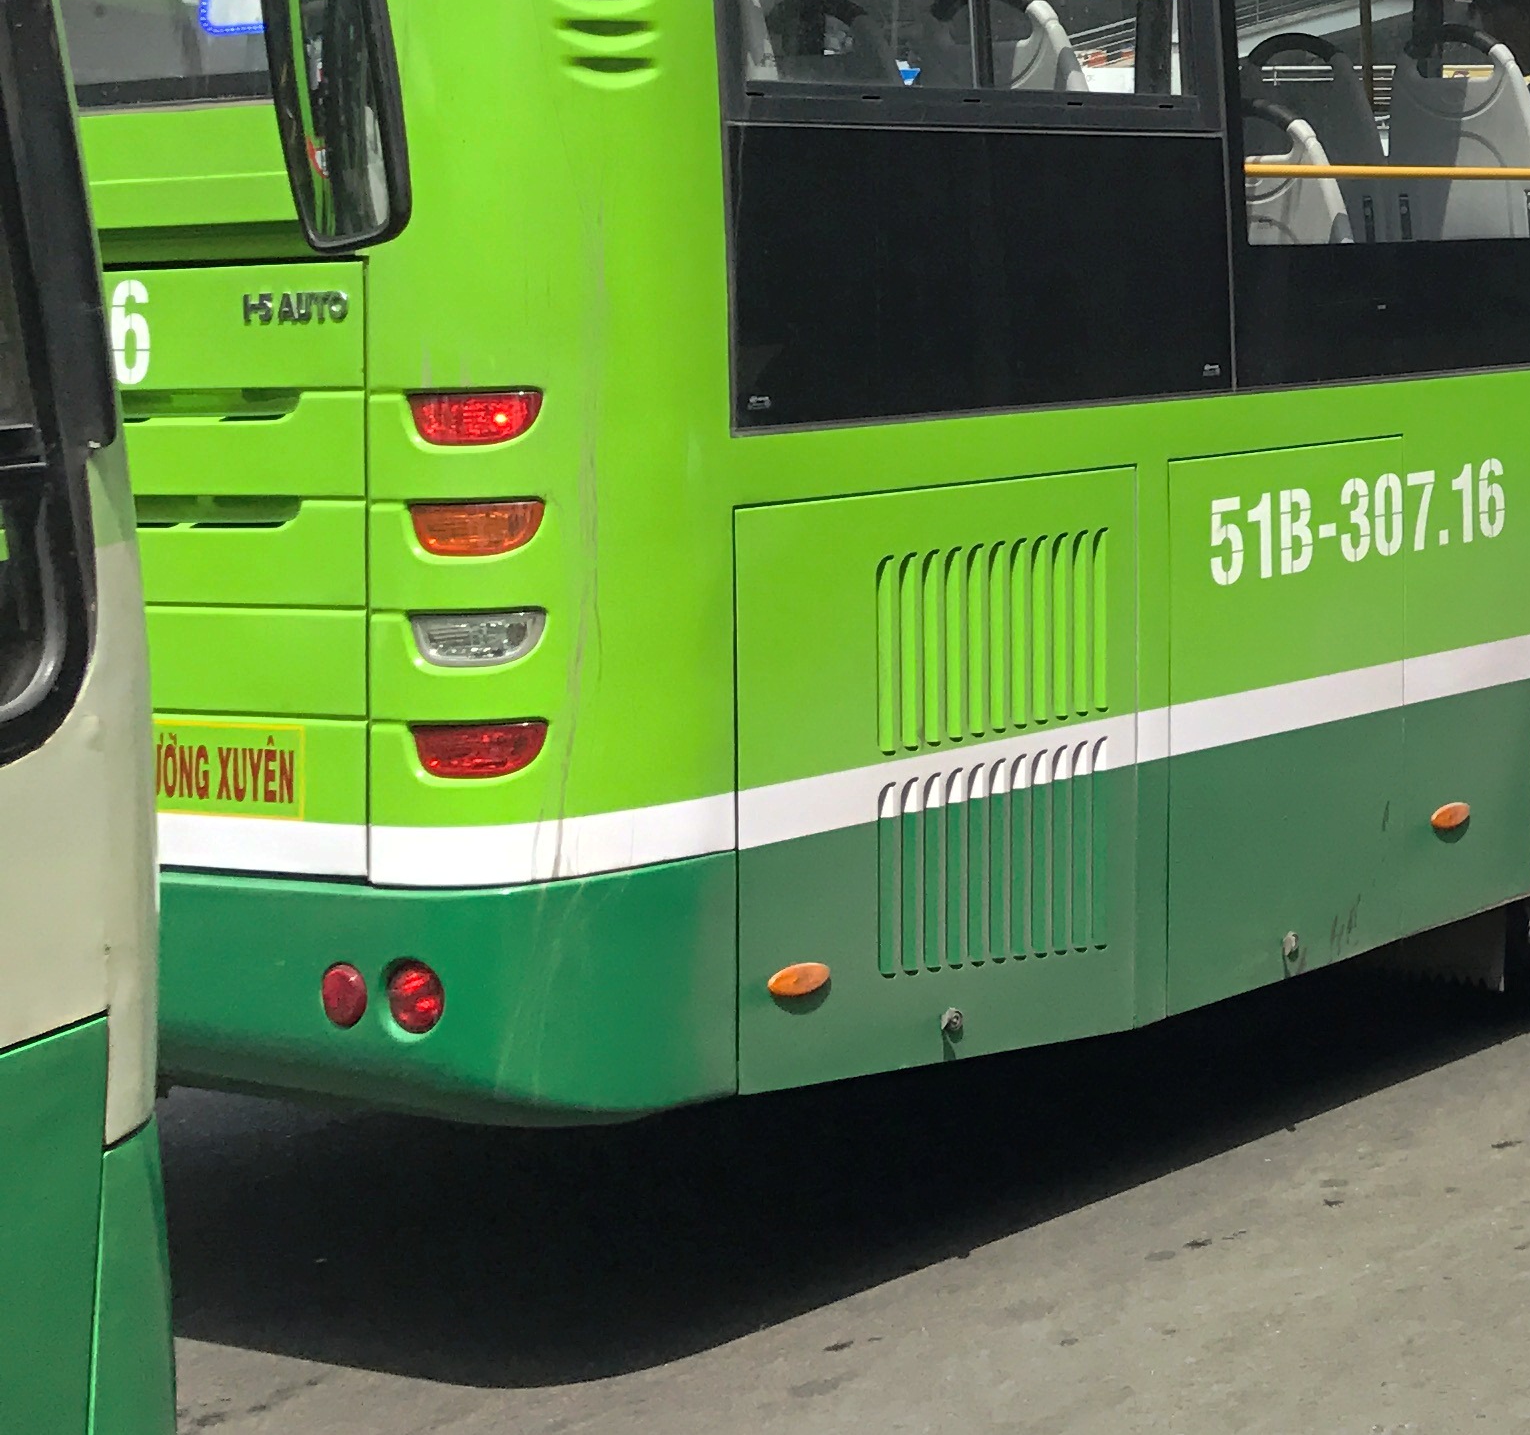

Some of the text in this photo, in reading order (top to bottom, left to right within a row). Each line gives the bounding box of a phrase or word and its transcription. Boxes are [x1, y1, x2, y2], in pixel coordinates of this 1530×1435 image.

[111, 279, 150, 386] 6
[277, 289, 349, 325] AUTO
[1209, 457, 1506, 587] 51B-307.16
[216, 734, 295, 804] XUYÊN
